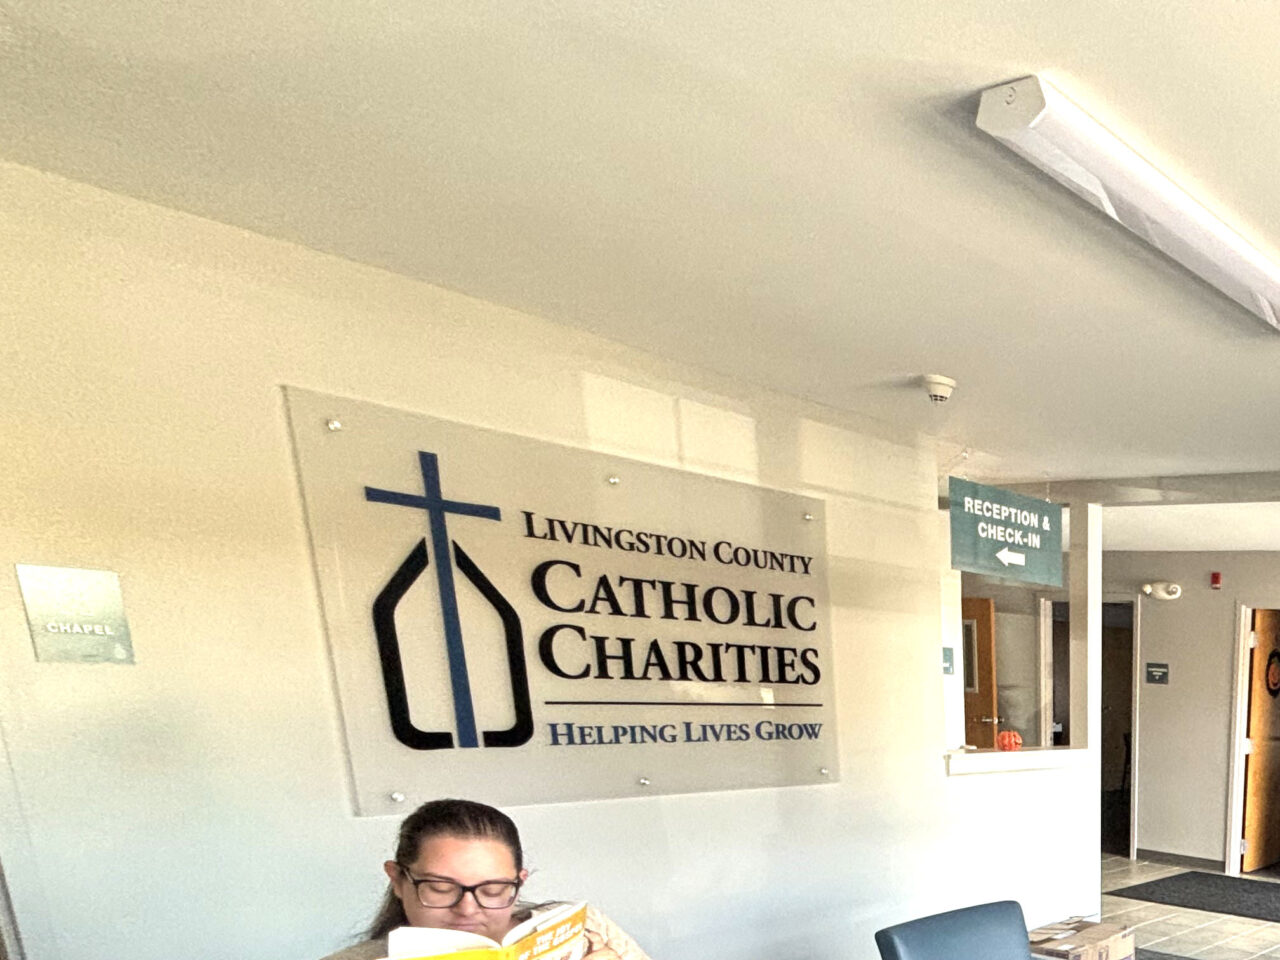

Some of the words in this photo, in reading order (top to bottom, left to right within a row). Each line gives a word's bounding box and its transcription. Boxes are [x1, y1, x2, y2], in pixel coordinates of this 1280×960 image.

[964, 497, 1039, 528] RECEPTION
[1042, 516, 1051, 531] &
[520, 510, 707, 561] LIVINGSTON
[713, 541, 812, 575] COUNTY
[977, 522, 1041, 549] CHECK-IN
[530, 559, 818, 632] CATHOLIC
[46, 622, 115, 635] CHAPEL
[538, 623, 822, 686] CHARITIES
[547, 722, 677, 746] HELPING
[682, 721, 751, 743] LIVES
[755, 720, 823, 741] GROW
